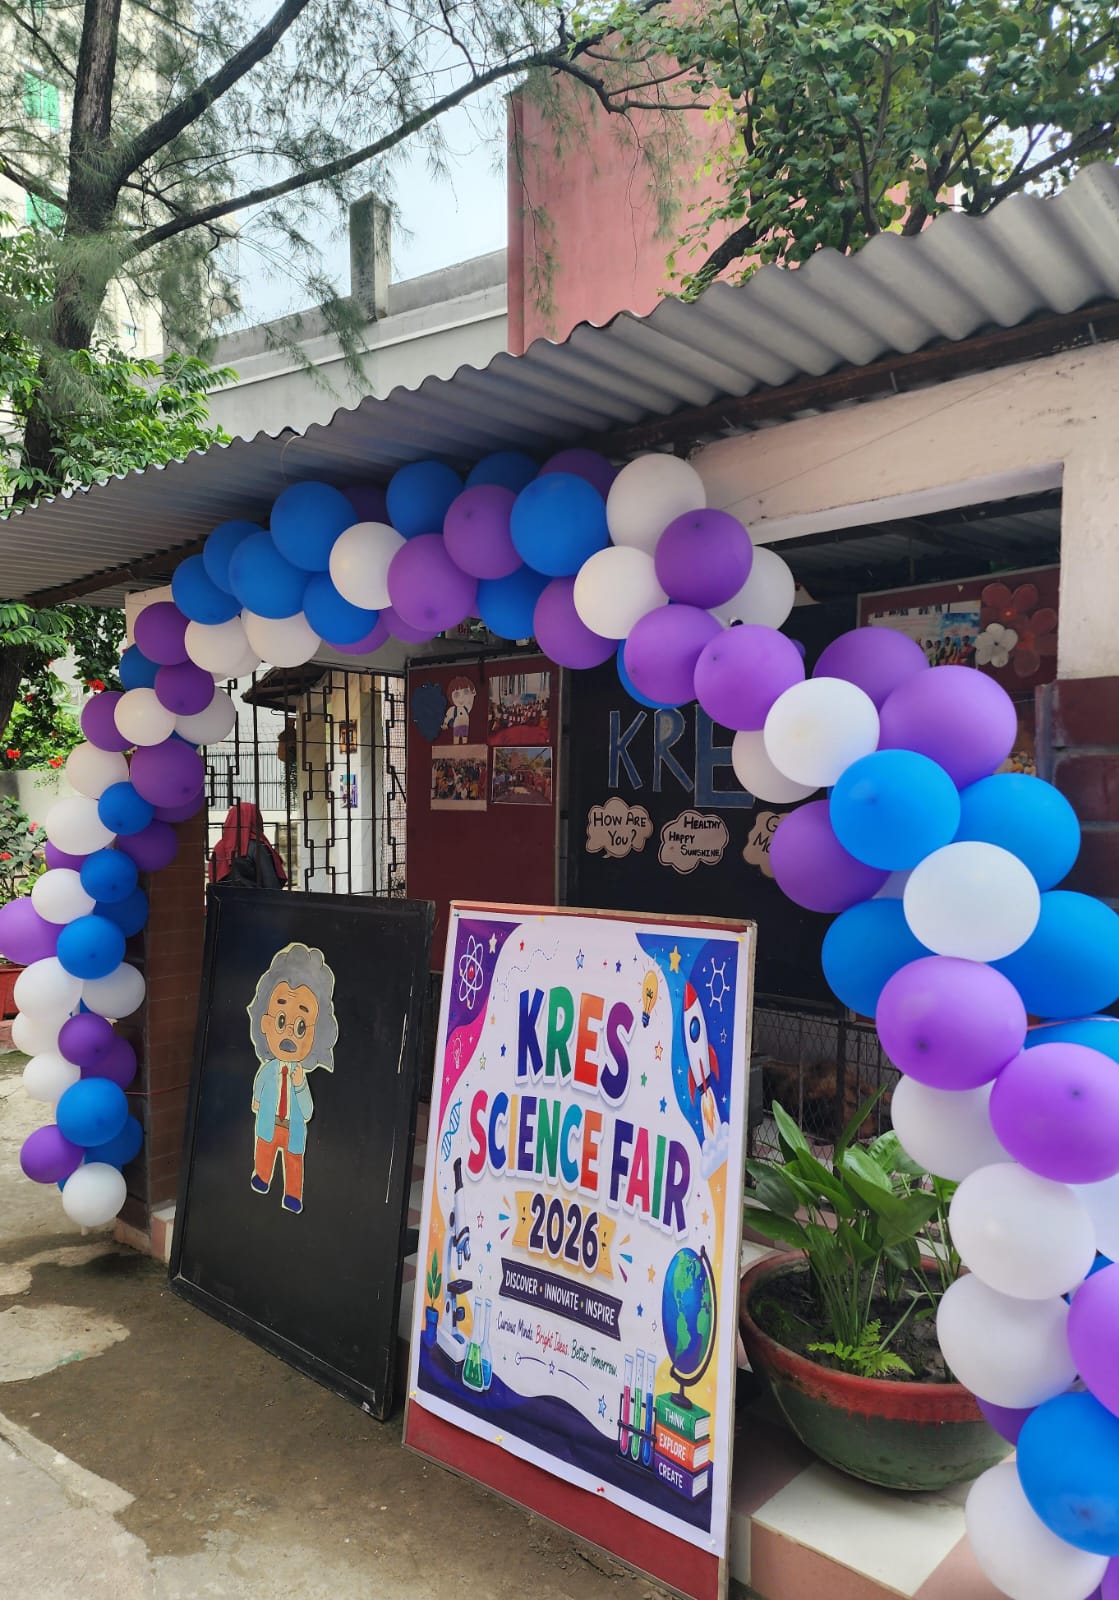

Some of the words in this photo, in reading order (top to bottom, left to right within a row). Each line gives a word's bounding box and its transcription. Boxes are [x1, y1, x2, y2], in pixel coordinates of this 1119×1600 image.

[680, 844, 720, 857] SUNSHINE
[517, 986, 634, 1100] KRES
[467, 1089, 603, 1192] SCIENCE
[609, 1118, 691, 1233] FAIR
[529, 1193, 598, 1268] 2026
[505, 1270, 538, 1296] DISCOVER
[544, 1282, 579, 1311] INNOVATE
[585, 1298, 615, 1326] INSPIRE
[497, 1310, 517, 1335] Curious
[536, 1324, 553, 1354] Bright
[571, 1338, 590, 1363] Better
[664, 1407, 685, 1431] THINK
[659, 1432, 687, 1461] EXPLORE
[658, 1462, 683, 1489] CREATE
